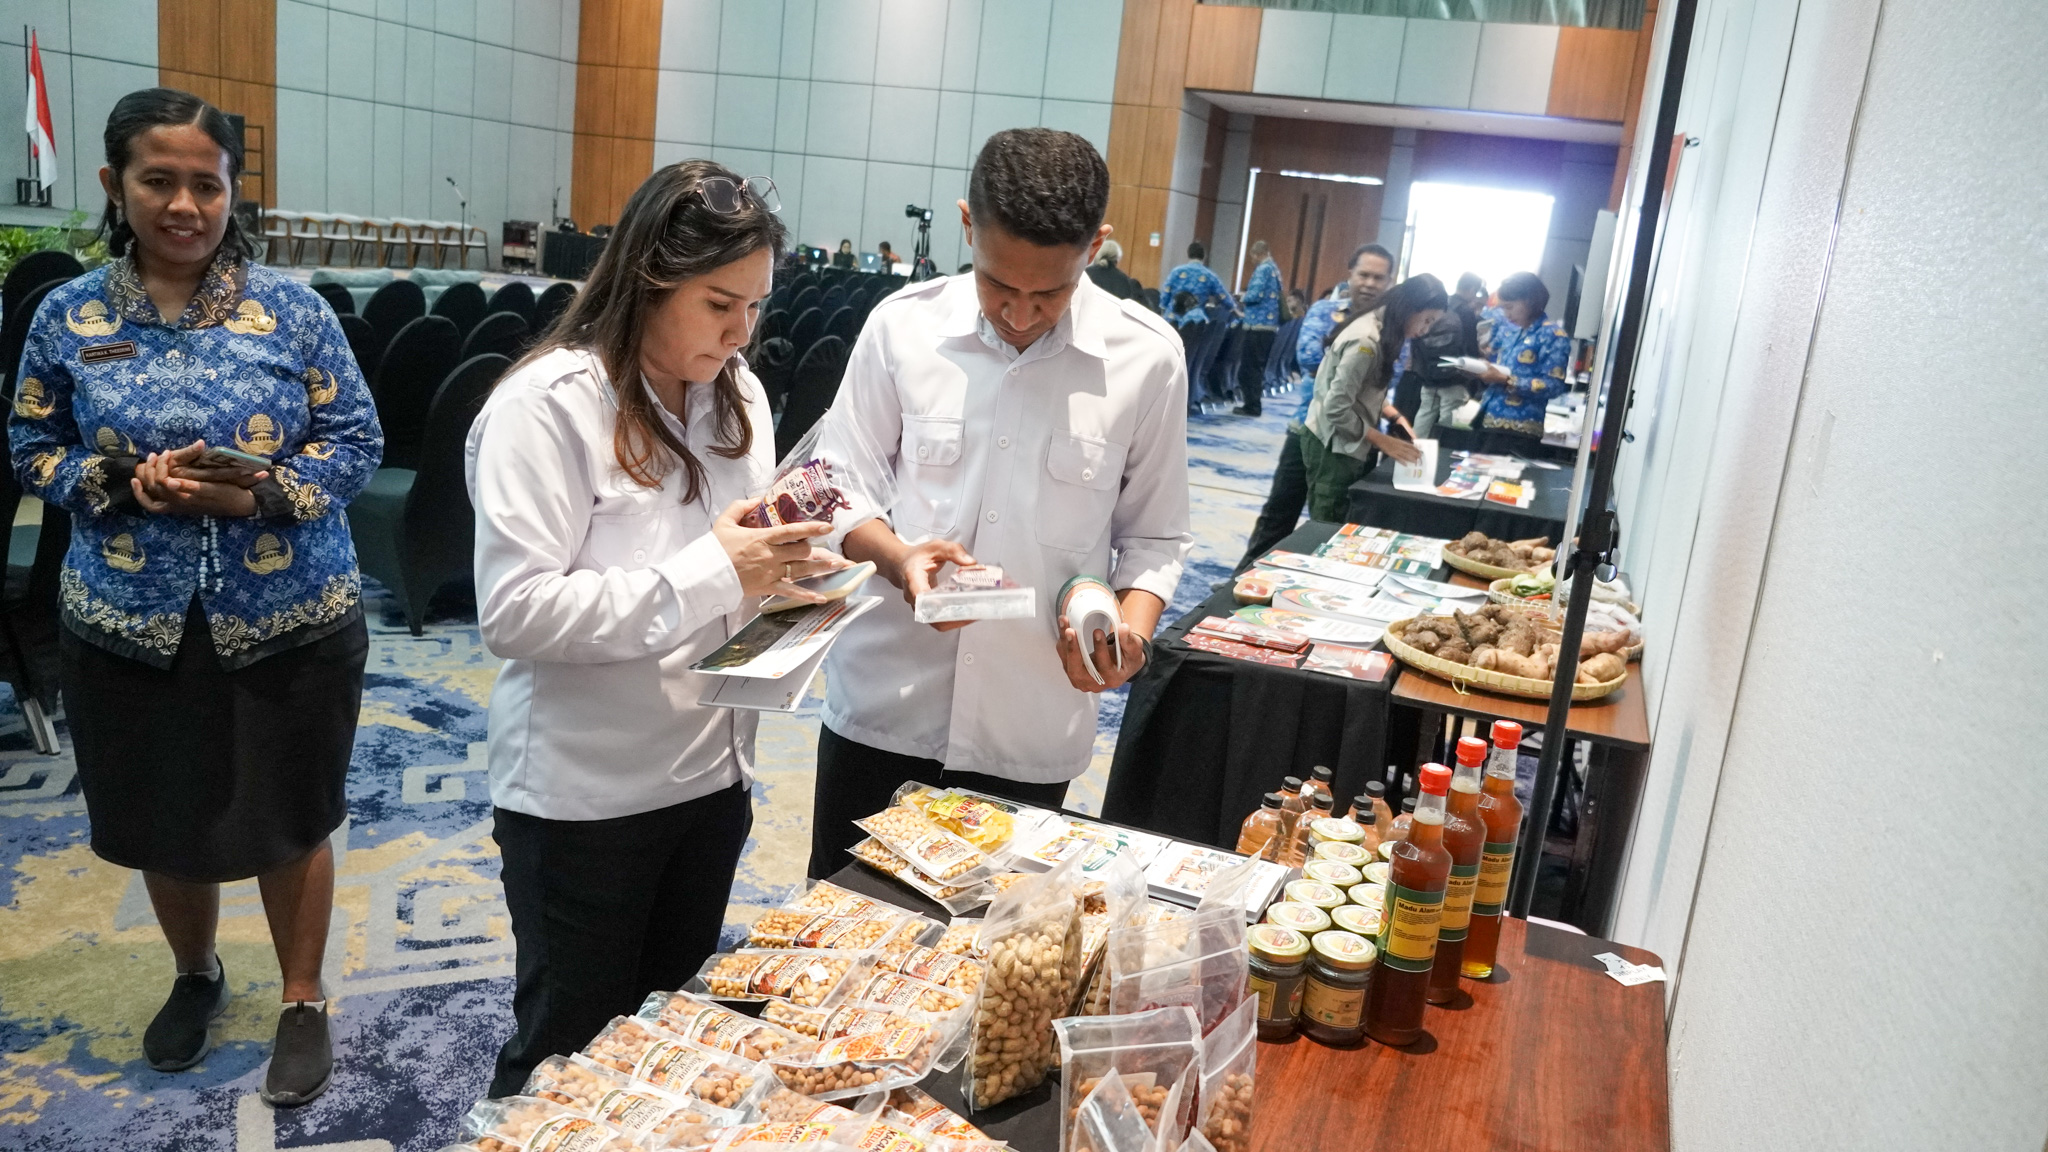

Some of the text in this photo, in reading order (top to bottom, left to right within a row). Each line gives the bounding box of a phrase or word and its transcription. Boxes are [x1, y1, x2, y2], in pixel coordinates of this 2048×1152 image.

[788, 478, 805, 508] UBI UNGU
[795, 480, 807, 498] STIK
[1399, 902, 1436, 913] Madu Alam
[677, 1055, 703, 1080] Kacang
[633, 1105, 663, 1129] Kacang
[863, 1128, 884, 1148] TELUR
[869, 1130, 898, 1152] KACAN
